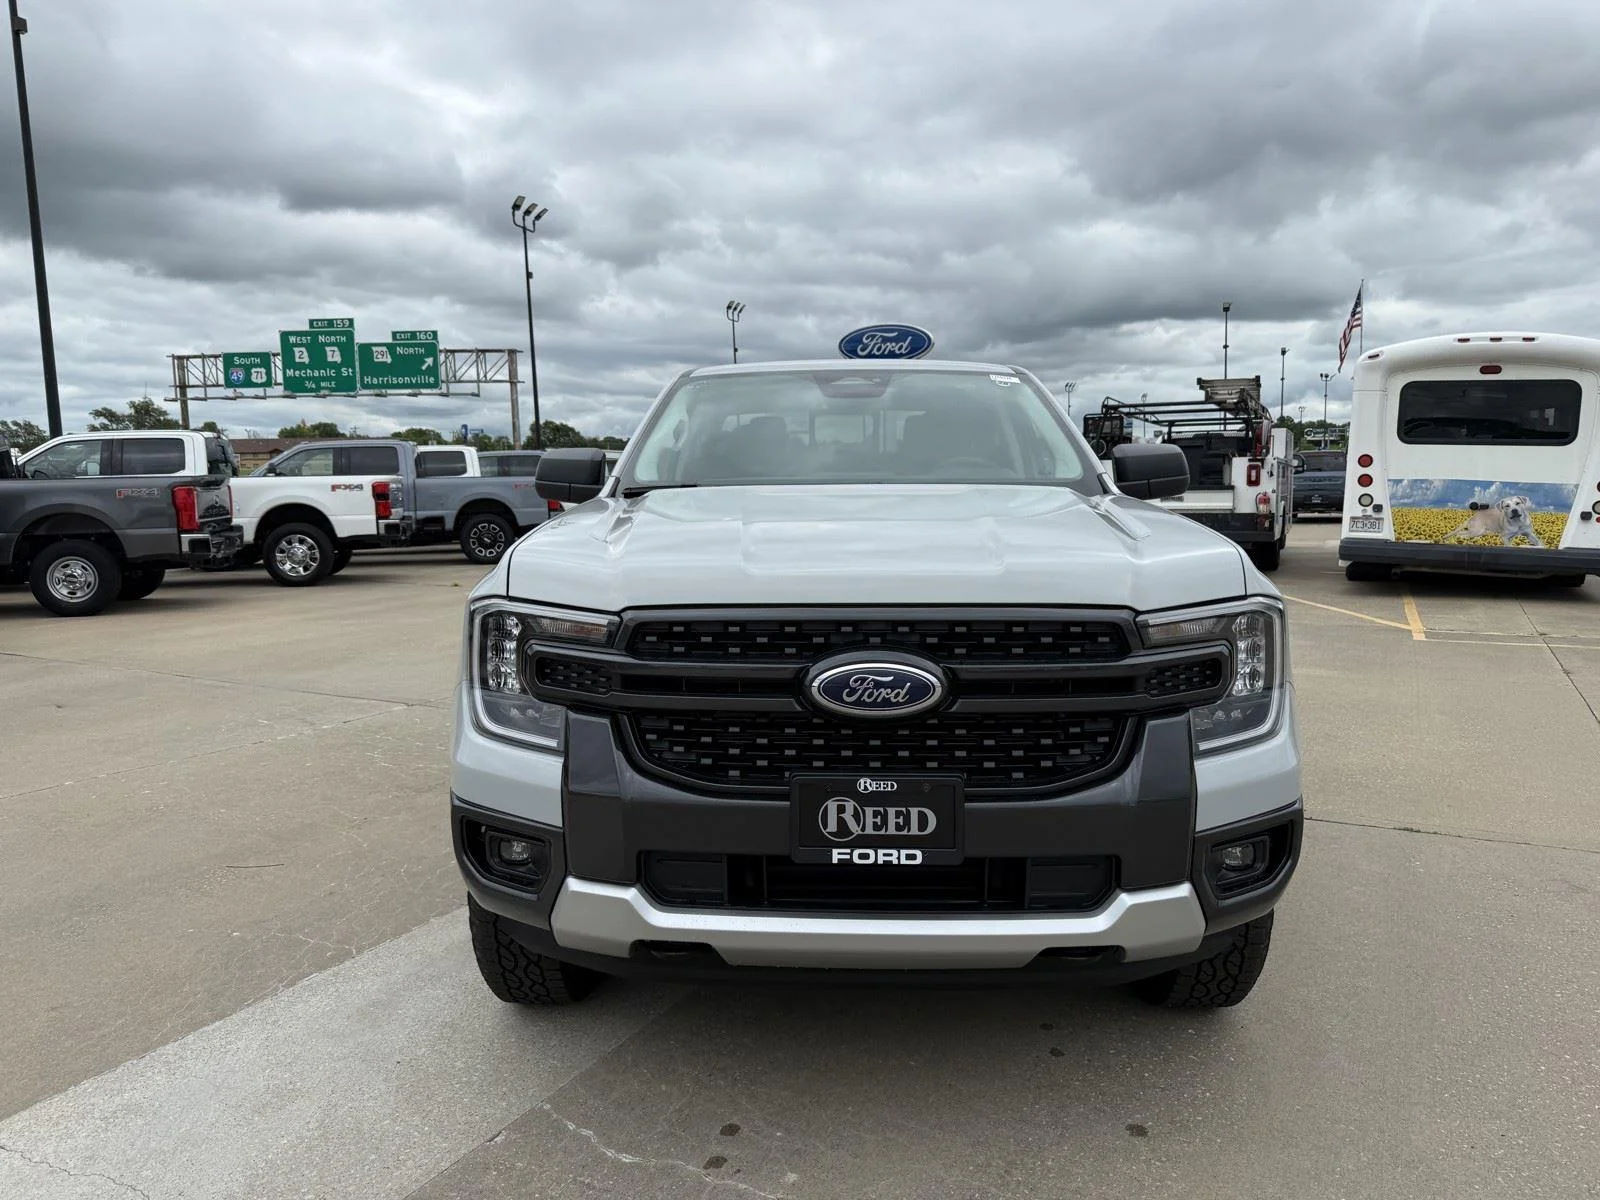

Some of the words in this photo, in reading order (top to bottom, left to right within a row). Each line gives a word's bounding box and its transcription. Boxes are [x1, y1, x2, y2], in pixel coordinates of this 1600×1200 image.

[333, 319, 349, 327] 159
[288, 335, 311, 343] WEST
[318, 334, 346, 342] NORTH
[416, 331, 433, 340] 160
[857, 331, 912, 356] Ford
[298, 350, 305, 359] 2
[329, 349, 336, 359] 7
[374, 350, 388, 359] 291
[396, 346, 425, 355] NORTH
[233, 356, 261, 365] SOUTH
[230, 371, 244, 380] 49
[253, 370, 264, 380] 71
[286, 368, 336, 377] Mechanic
[341, 367, 353, 376] St
[363, 375, 435, 384] Harrisonville
[842, 674, 911, 703] Ford
[857, 777, 897, 793] REED
[818, 796, 937, 841] REED
[831, 849, 923, 865] FORD
